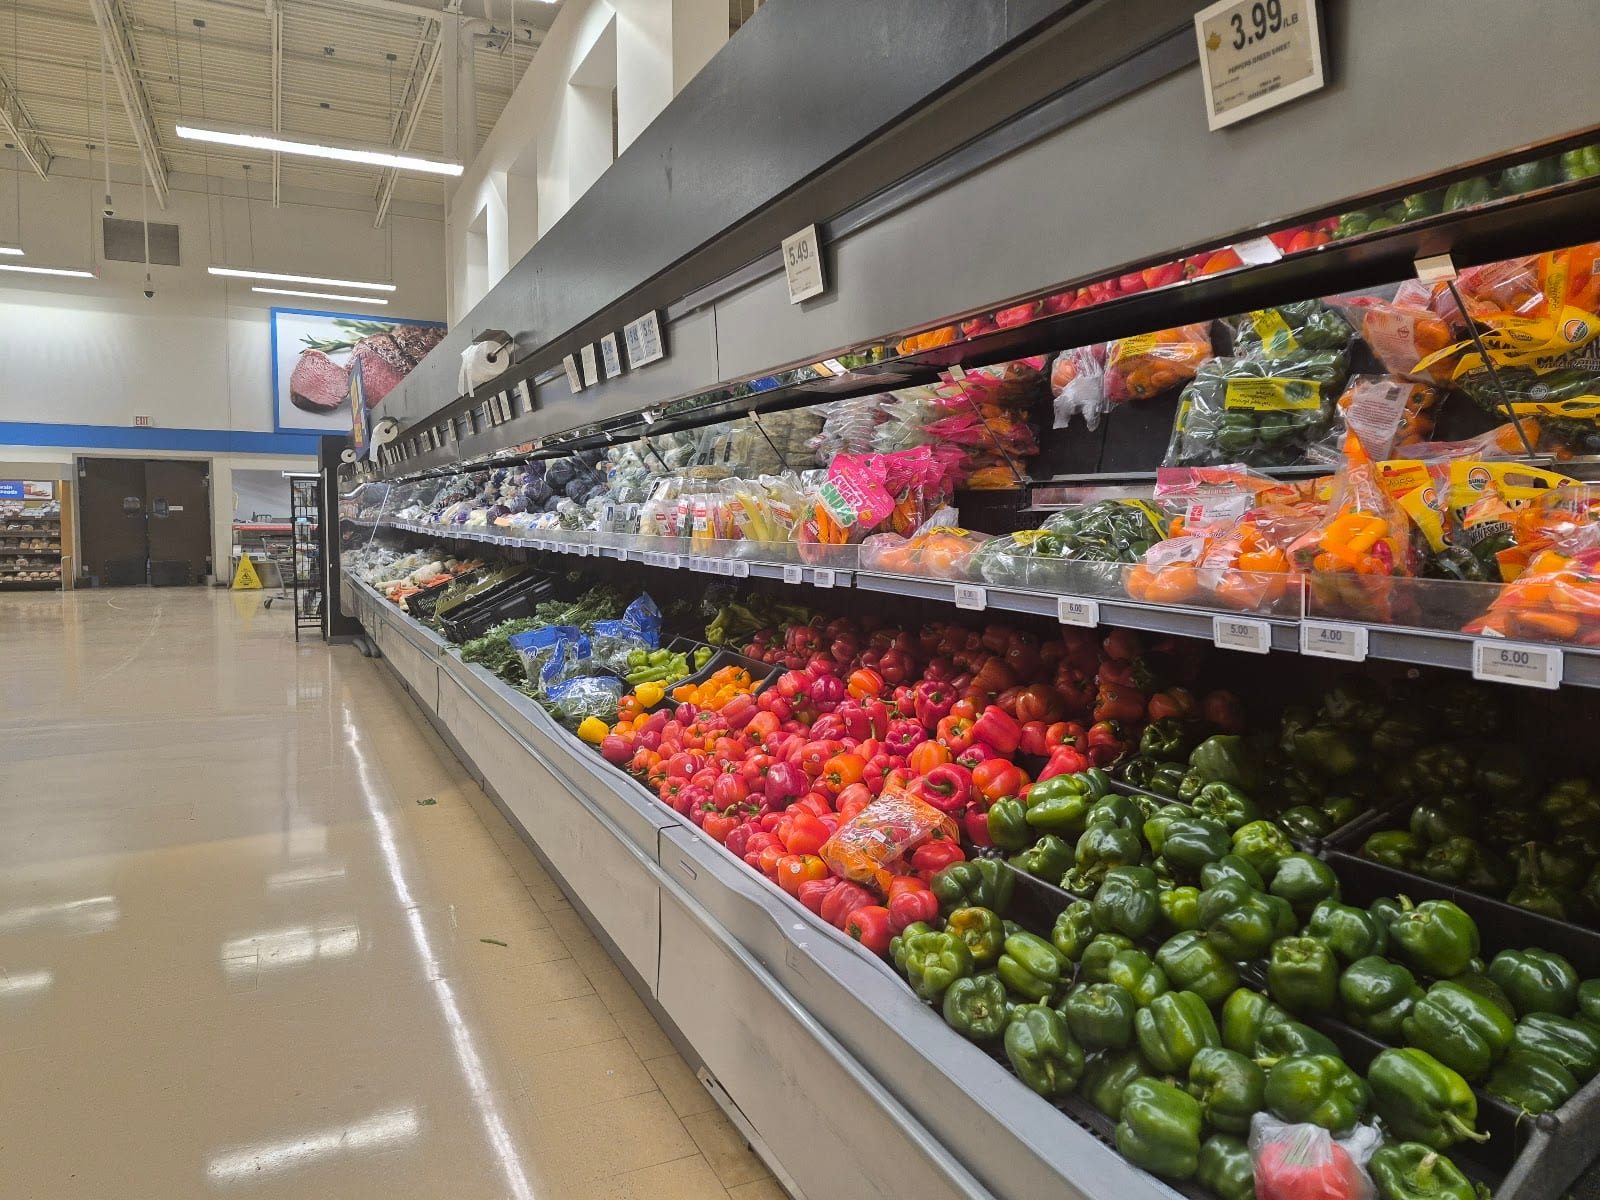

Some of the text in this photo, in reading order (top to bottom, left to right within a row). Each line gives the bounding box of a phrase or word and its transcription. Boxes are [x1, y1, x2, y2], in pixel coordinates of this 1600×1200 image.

[1231, 0, 1282, 50] 3.99
[788, 239, 809, 266] 5.49
[135, 416, 148, 425] EXIT
[1230, 624, 1248, 635] 5.00
[1320, 628, 1342, 641] 4.00
[1500, 649, 1529, 665] 6.00
